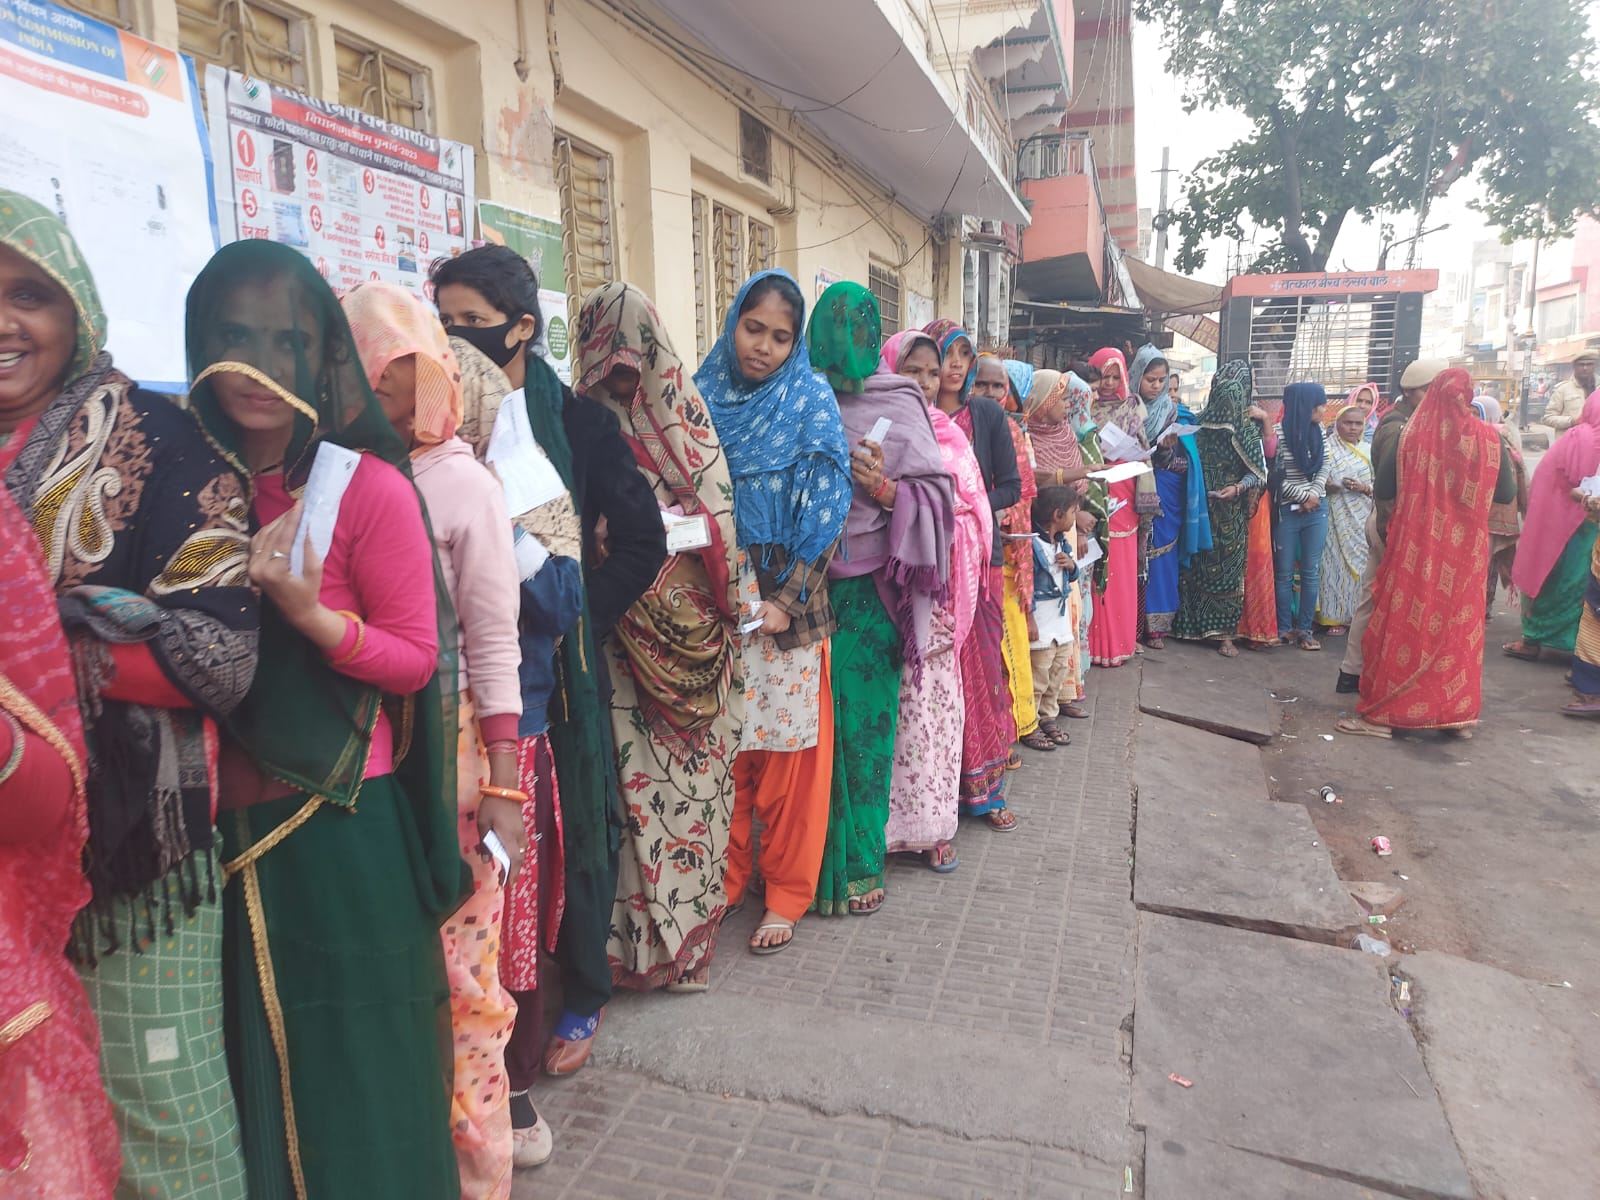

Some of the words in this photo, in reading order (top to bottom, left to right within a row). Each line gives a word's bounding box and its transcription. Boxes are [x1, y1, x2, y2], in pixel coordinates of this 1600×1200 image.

[16, 16, 99, 53] COMMISSION
[101, 46, 117, 59] OF
[18, 32, 55, 54] INDIA
[240, 134, 251, 163] 1
[244, 193, 256, 214] 5
